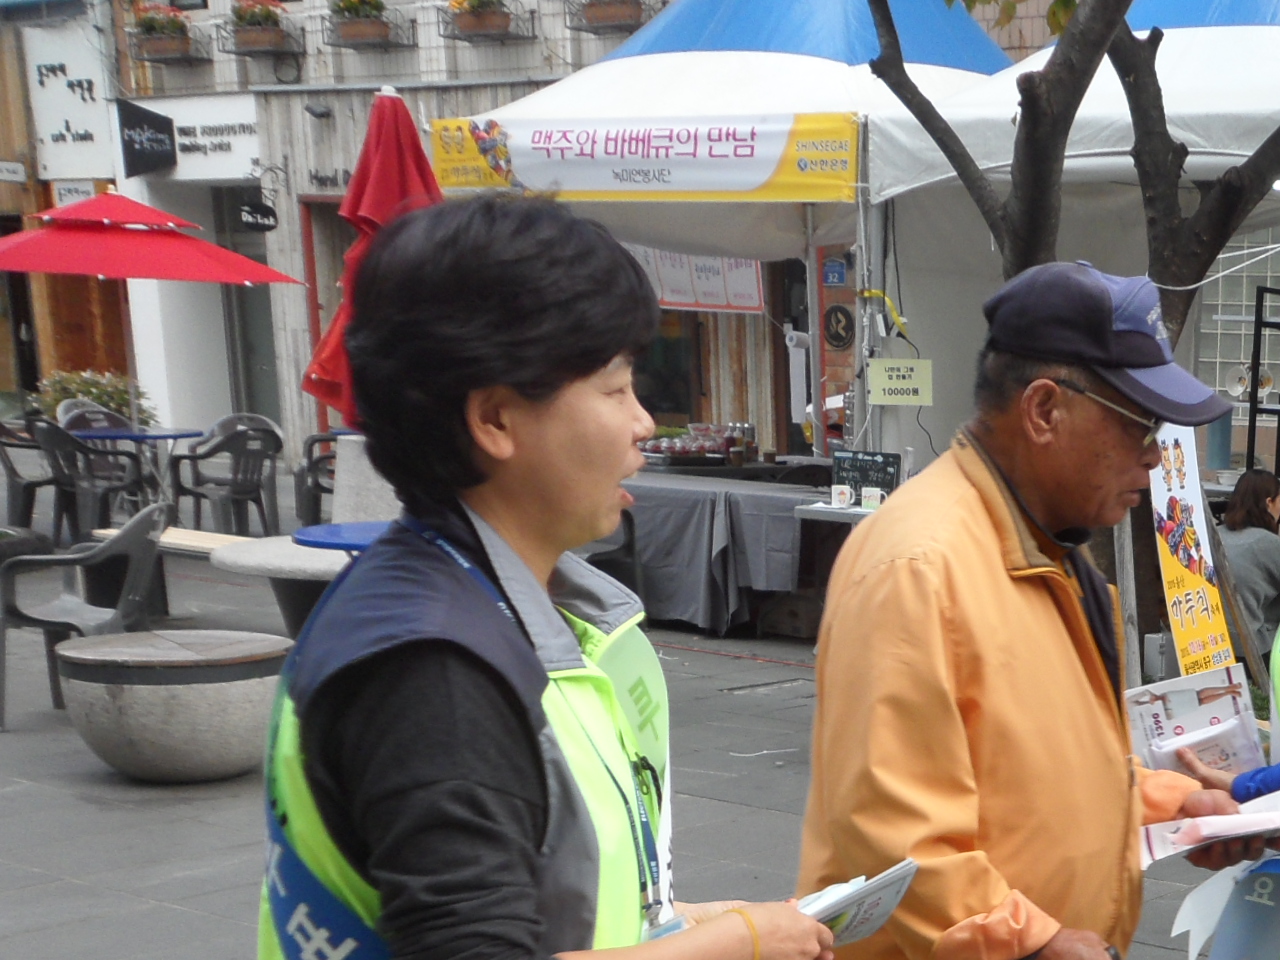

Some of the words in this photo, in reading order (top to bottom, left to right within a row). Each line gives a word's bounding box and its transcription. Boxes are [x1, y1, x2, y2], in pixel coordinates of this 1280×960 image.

[531, 128, 597, 160] 맥주와
[603, 126, 699, 160] 바베큐의
[706, 125, 757, 158] 만남
[795, 138, 850, 153] SHINSEGAE
[808, 157, 850, 174] 신한은행
[826, 272, 839, 283] 32
[881, 387, 920, 397] 10000원
